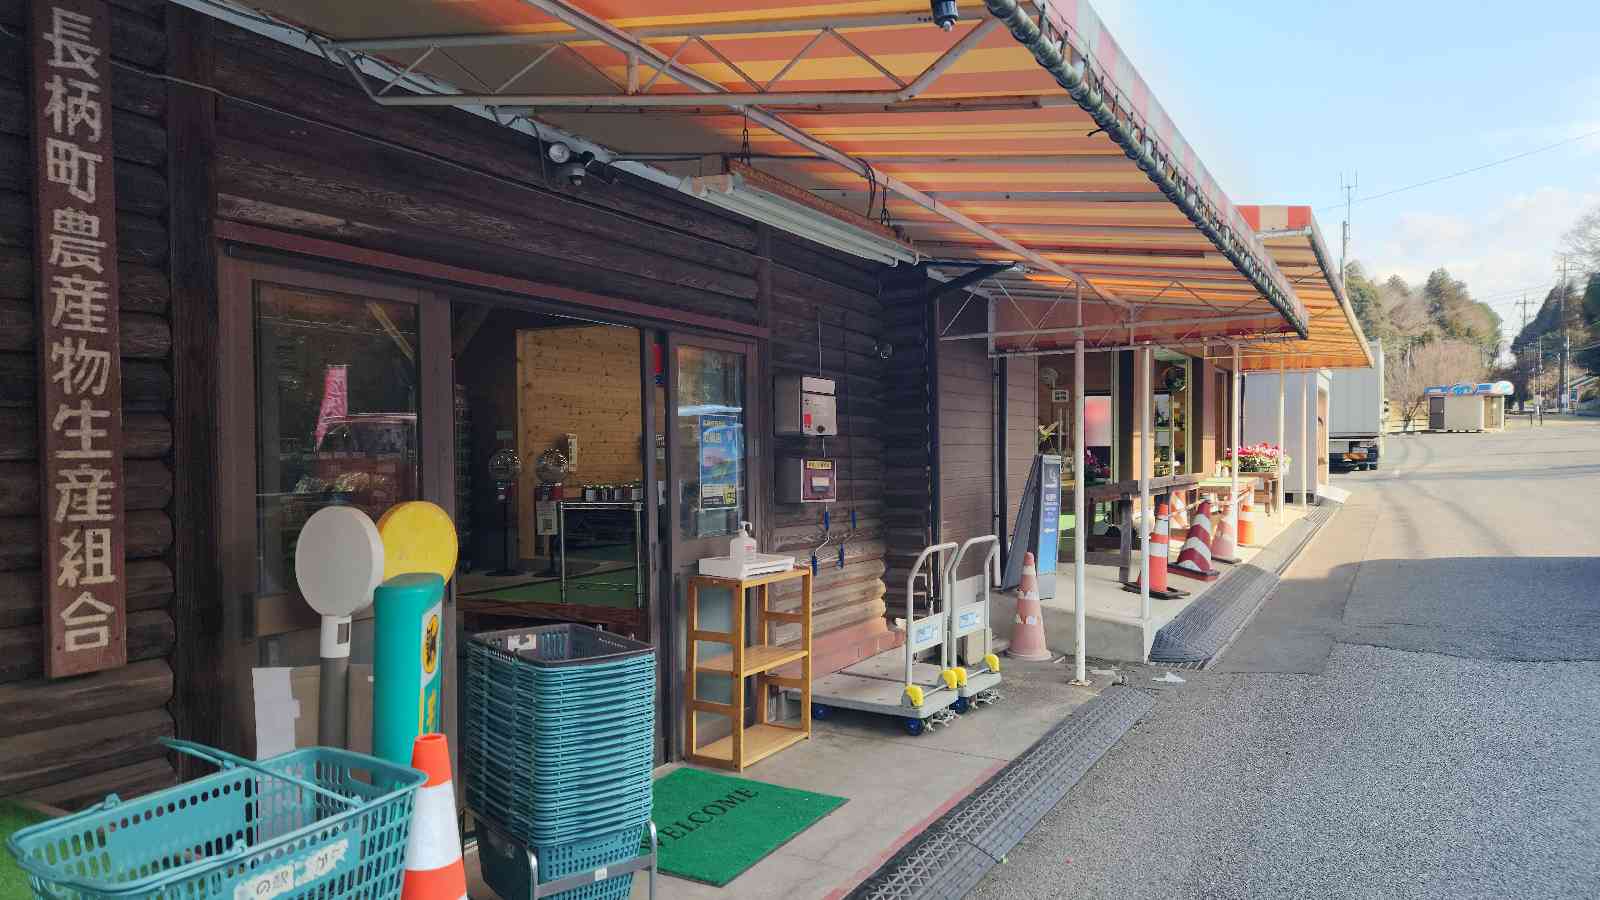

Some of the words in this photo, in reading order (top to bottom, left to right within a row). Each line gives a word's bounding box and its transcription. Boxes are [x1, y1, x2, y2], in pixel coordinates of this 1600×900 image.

[42, 7, 117, 653] 長柄町農産物生産組合
